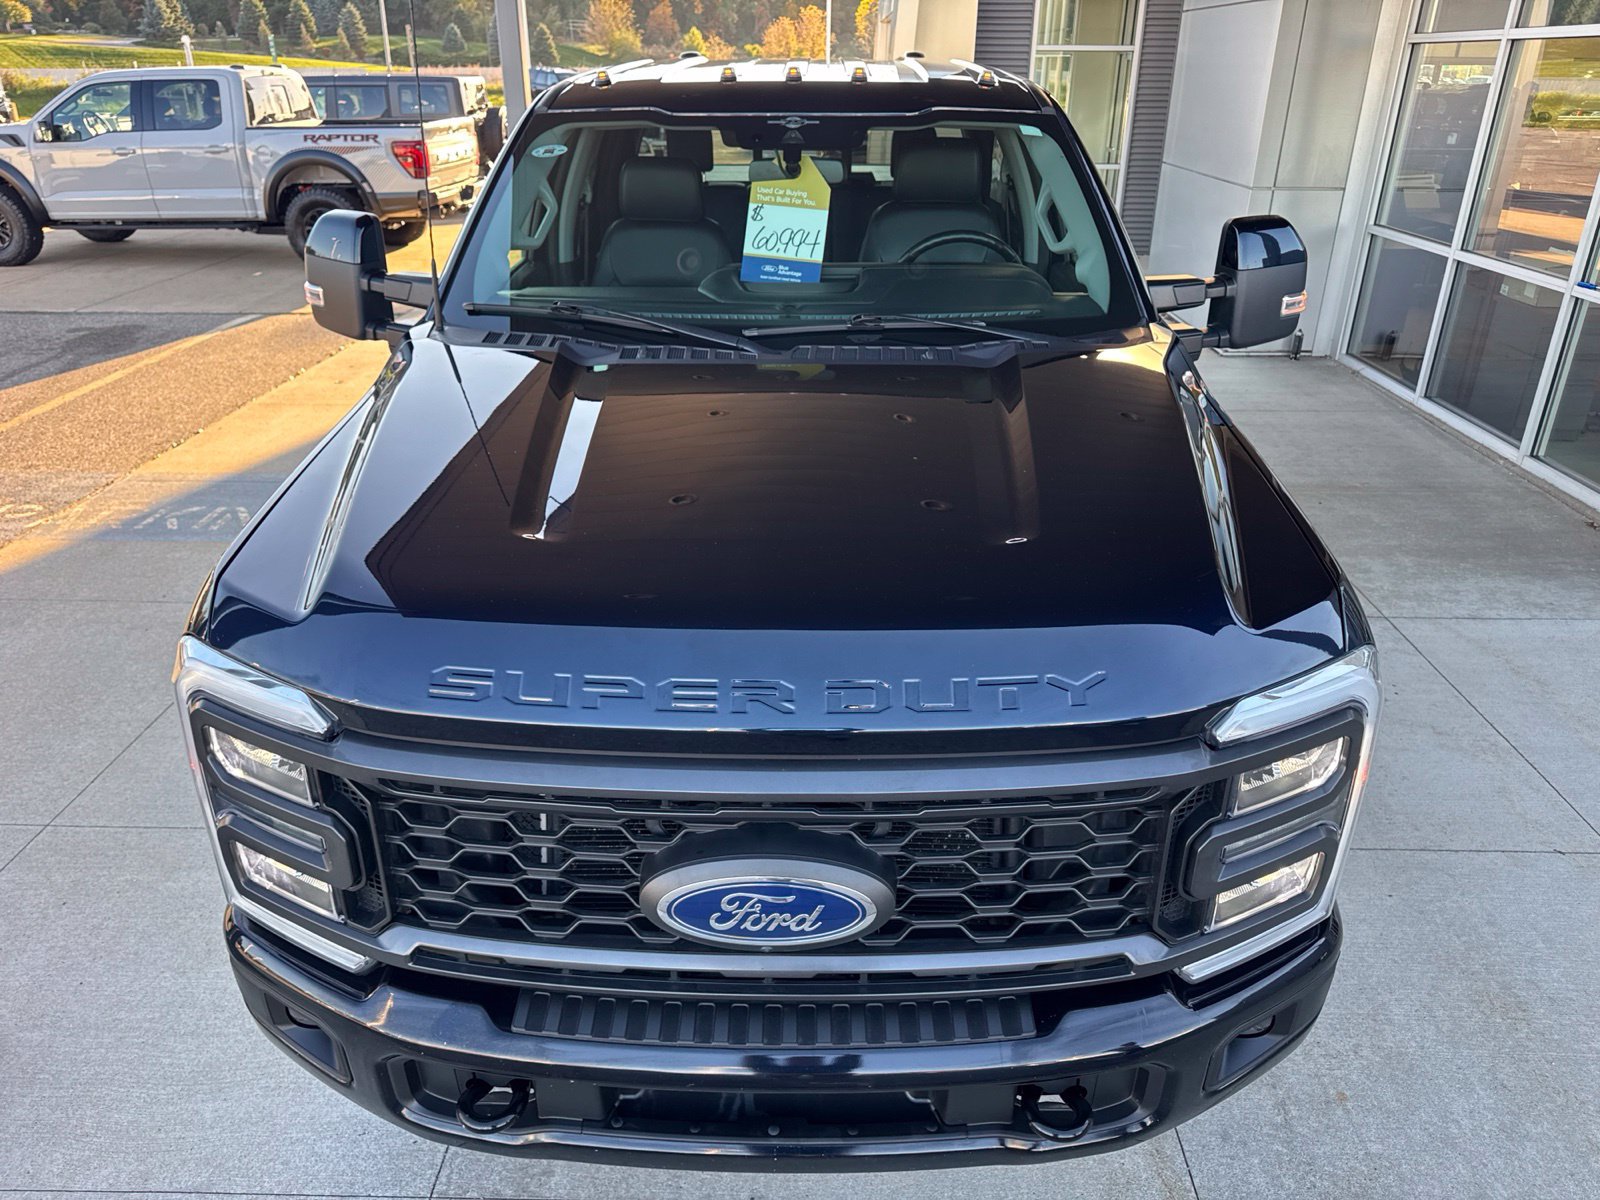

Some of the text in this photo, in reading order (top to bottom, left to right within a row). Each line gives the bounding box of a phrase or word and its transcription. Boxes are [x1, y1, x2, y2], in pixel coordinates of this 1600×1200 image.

[303, 133, 382, 145] RAPTOR
[757, 186, 808, 198] Used Car Buying
[757, 193, 776, 202] That's
[776, 195, 790, 203] Built
[751, 203, 764, 222] $
[778, 269, 802, 278] Advantage
[428, 665, 1107, 715] SUPER DUTY
[708, 892, 826, 932] Ford
